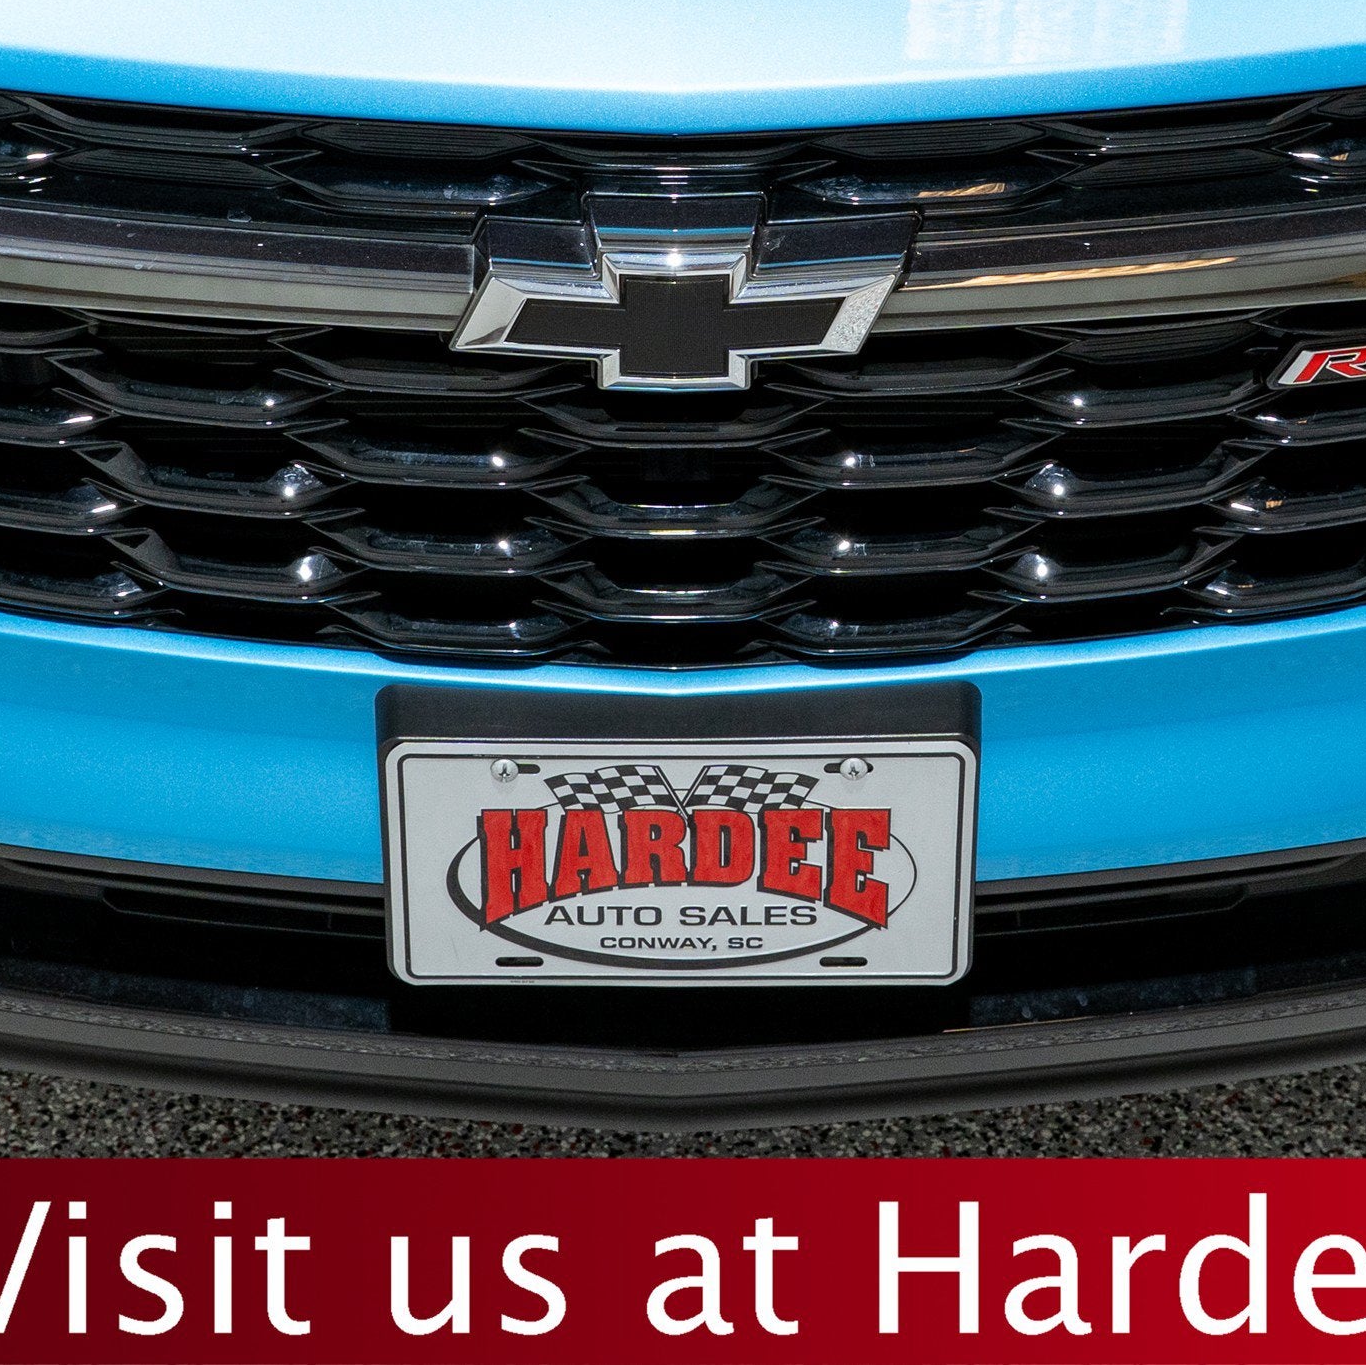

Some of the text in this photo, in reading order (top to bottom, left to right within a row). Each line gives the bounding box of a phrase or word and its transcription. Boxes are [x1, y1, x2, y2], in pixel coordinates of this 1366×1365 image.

[478, 808, 892, 930] HARDEE
[543, 905, 818, 926] AUTO SALES
[599, 936, 764, 952] CONWAY, SC
